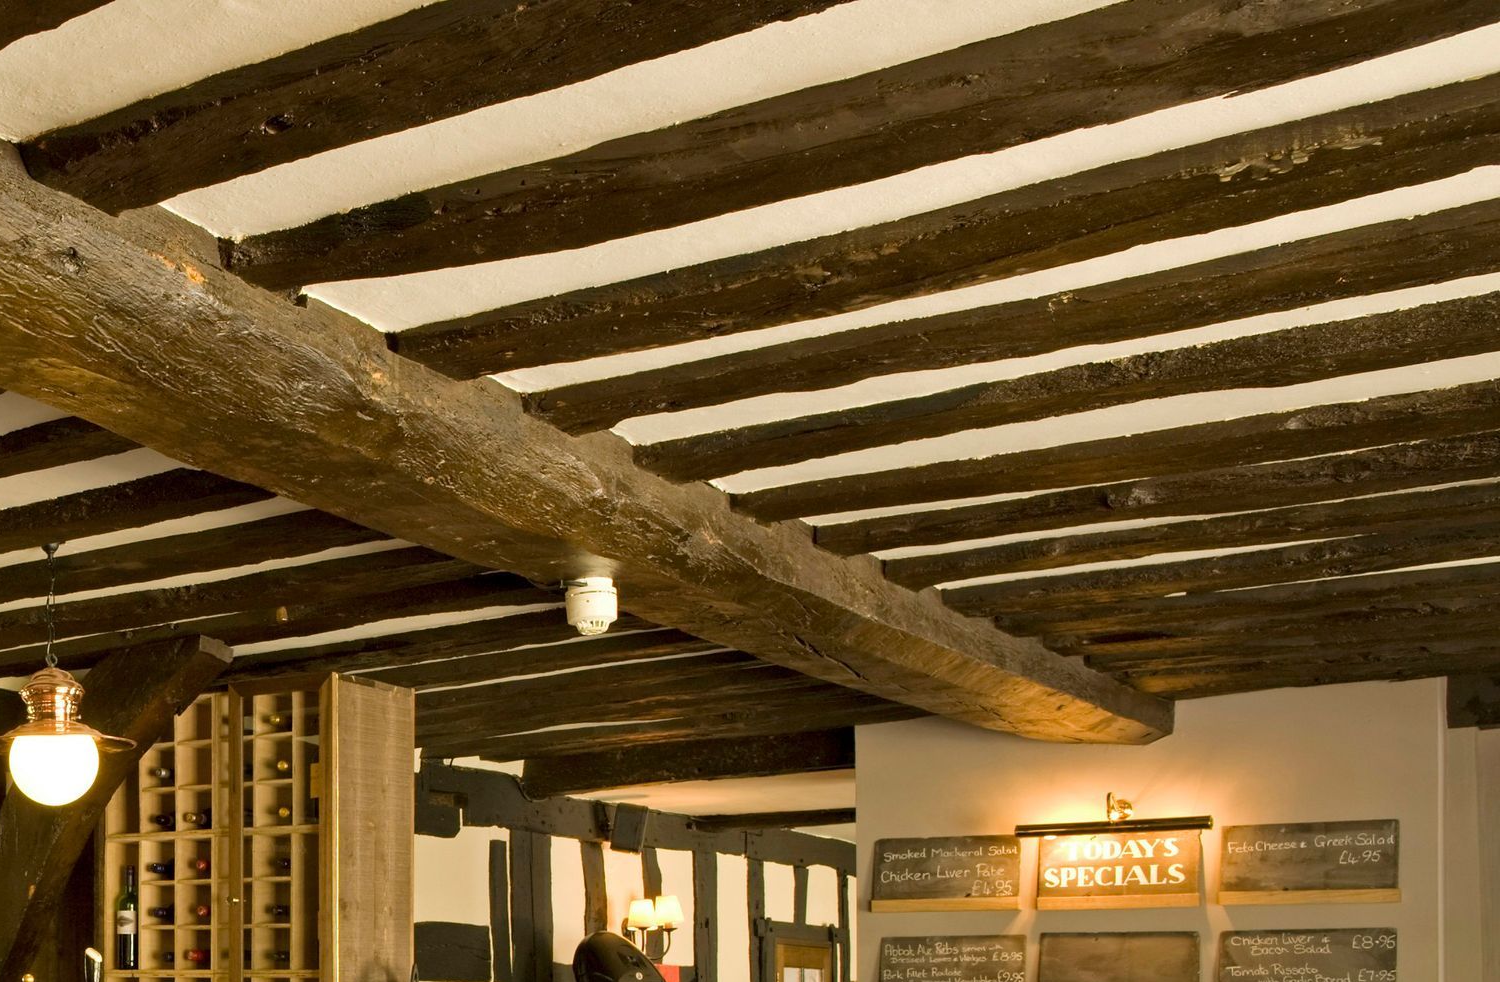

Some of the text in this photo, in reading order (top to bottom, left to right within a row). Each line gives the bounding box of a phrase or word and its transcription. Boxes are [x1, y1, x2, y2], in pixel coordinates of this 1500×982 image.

[1059, 838, 1179, 861] TODAY'S
[1227, 841, 1254, 854] Feta
[1255, 840, 1297, 851] Cheese
[1314, 834, 1351, 848] Greek
[1355, 833, 1395, 846] Salad
[883, 848, 926, 862] Smoked
[987, 846, 1018, 856] Salad
[881, 863, 1005, 883] Chicken Liver Pate
[1044, 863, 1186, 888] SPECIALS
[1230, 935, 1279, 946] Chicken
[1282, 933, 1315, 944] Liver
[934, 941, 959, 955] Ribs
[1251, 944, 1332, 956] Bacon Salad
[884, 969, 904, 980] Pork
[1226, 965, 1269, 977] Tomato
